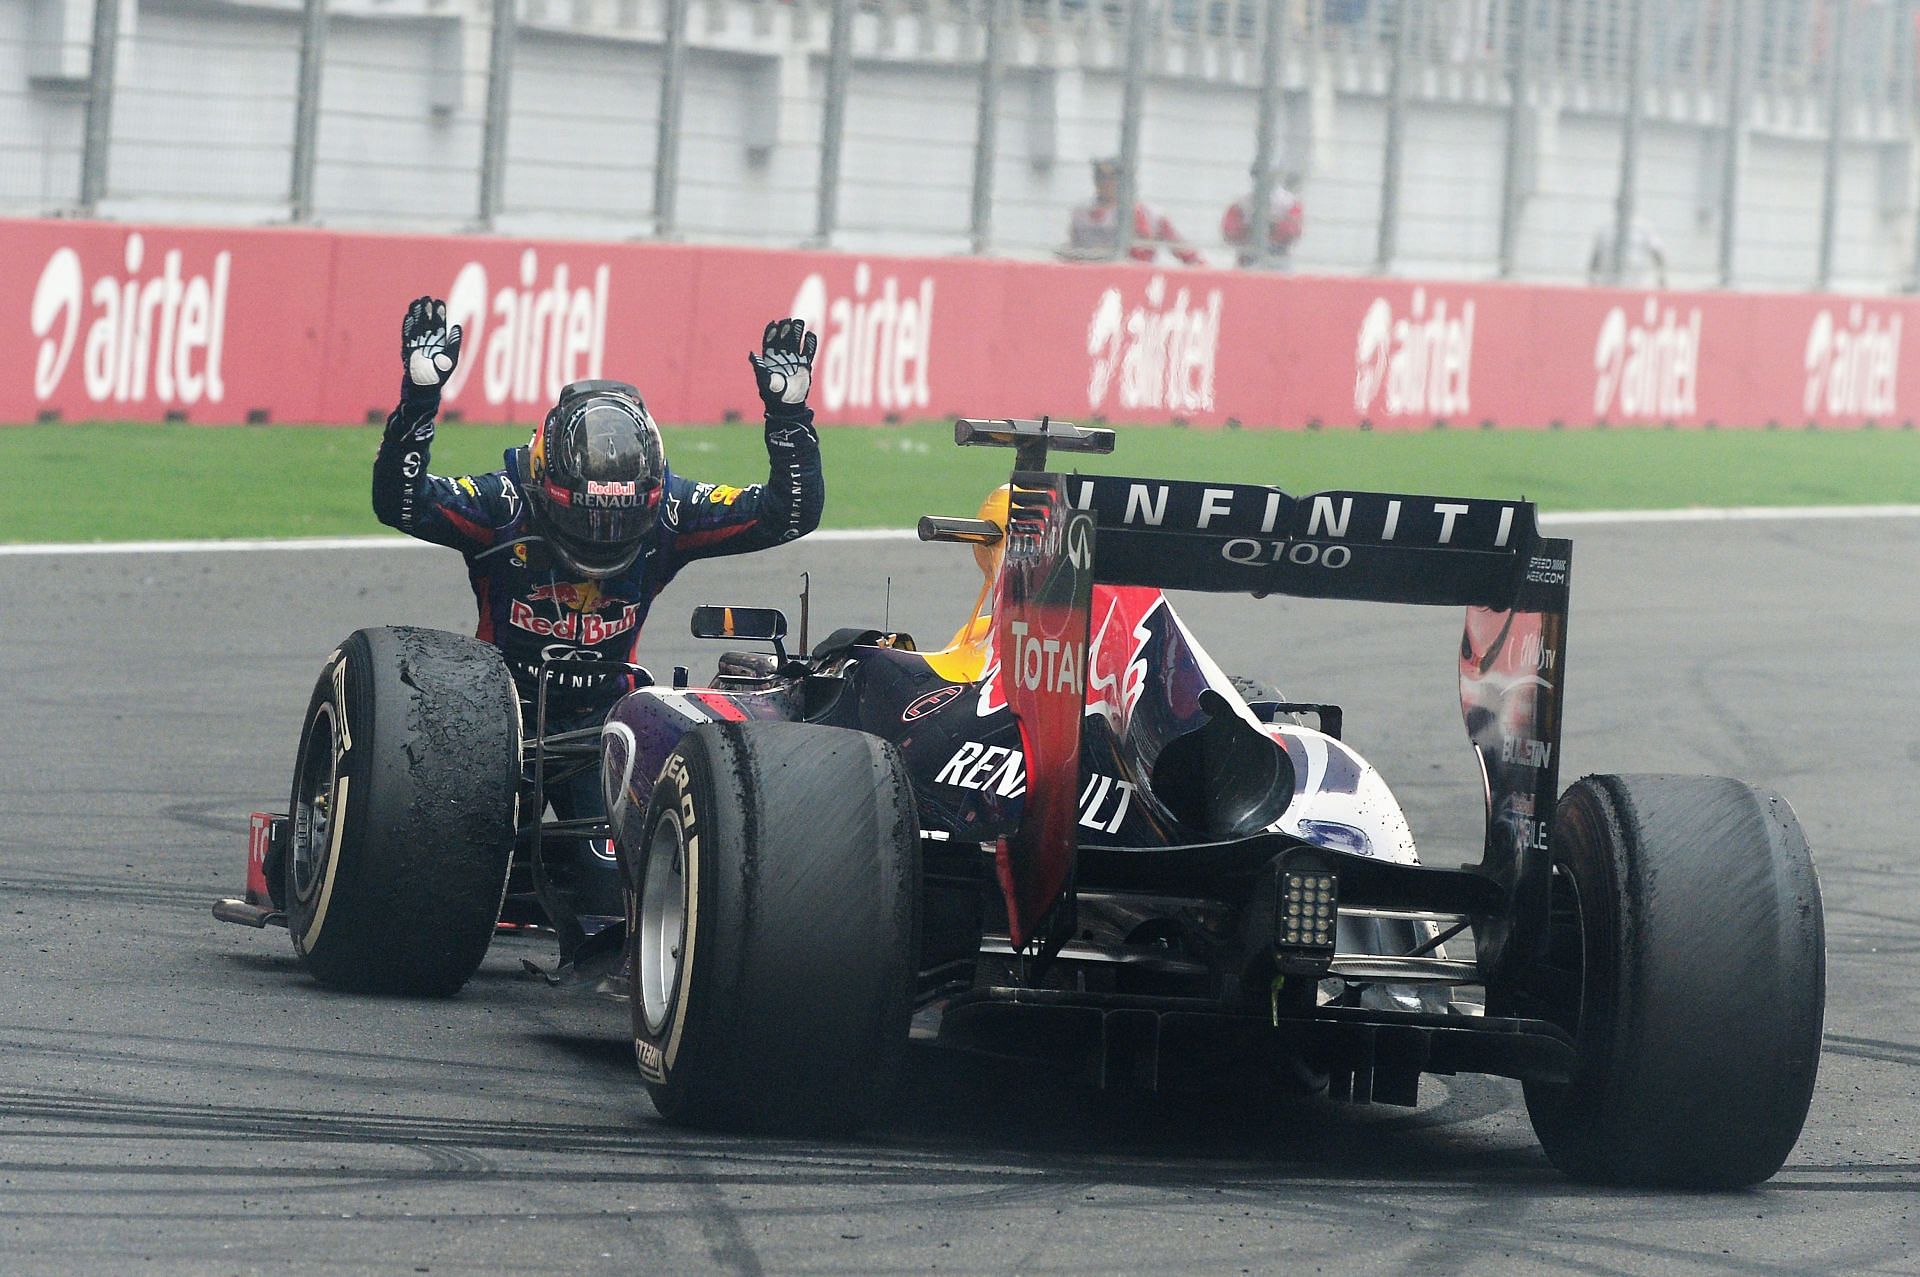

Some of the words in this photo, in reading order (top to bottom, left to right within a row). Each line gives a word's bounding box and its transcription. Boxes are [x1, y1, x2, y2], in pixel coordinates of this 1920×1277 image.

[84, 233, 231, 403] airtel
[484, 248, 611, 405] airtel
[822, 262, 935, 412] airtel
[573, 492, 648, 508] RENAULT
[587, 480, 613, 495] Red
[613, 481, 635, 496] Bull
[1077, 480, 1514, 547] INFINITI
[1221, 538, 1352, 570] Q100
[510, 598, 577, 640] Red
[581, 601, 641, 646] Bull
